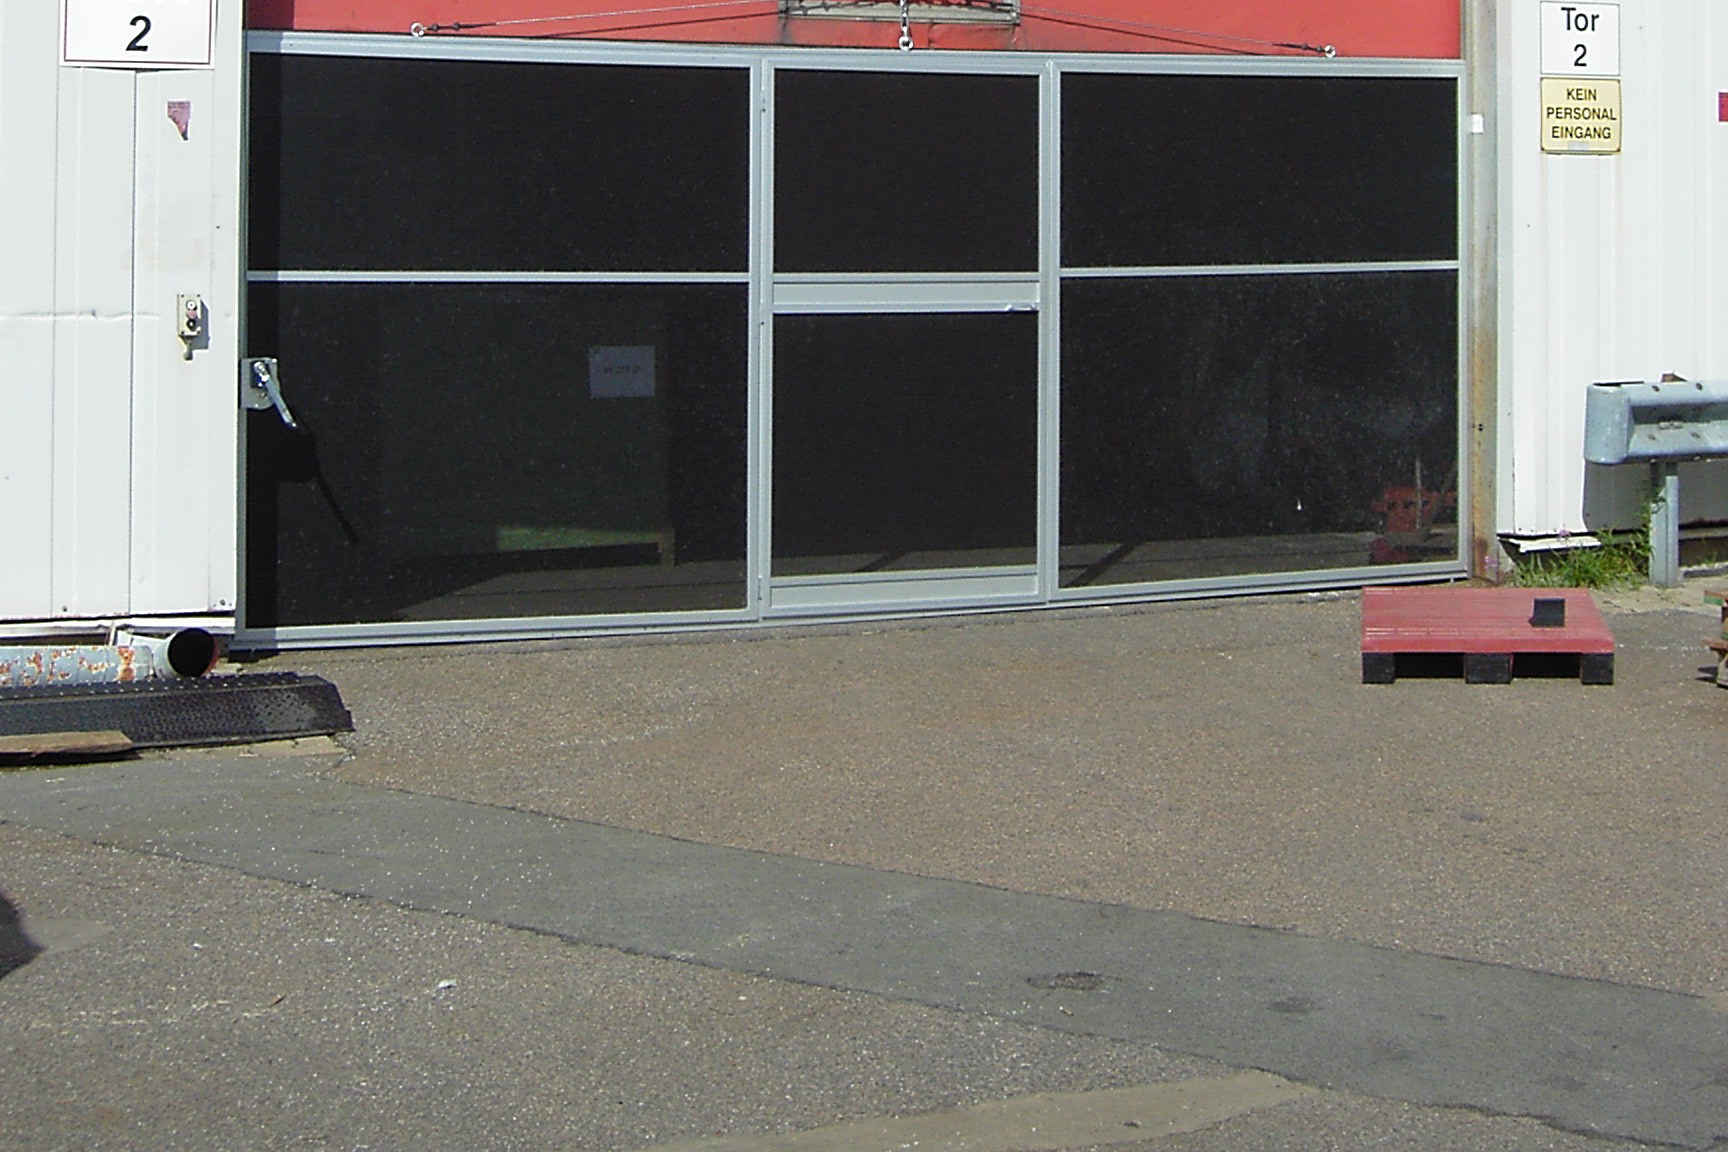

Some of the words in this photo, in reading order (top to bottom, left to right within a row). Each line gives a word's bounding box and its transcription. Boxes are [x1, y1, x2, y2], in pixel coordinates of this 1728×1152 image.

[1560, 6, 1600, 32] Tor
[125, 15, 152, 52] 2
[1573, 43, 1588, 67] 2
[1566, 88, 1597, 101] KEIN
[1546, 106, 1617, 121] PERSONAL
[1551, 125, 1612, 139] EINGANG
